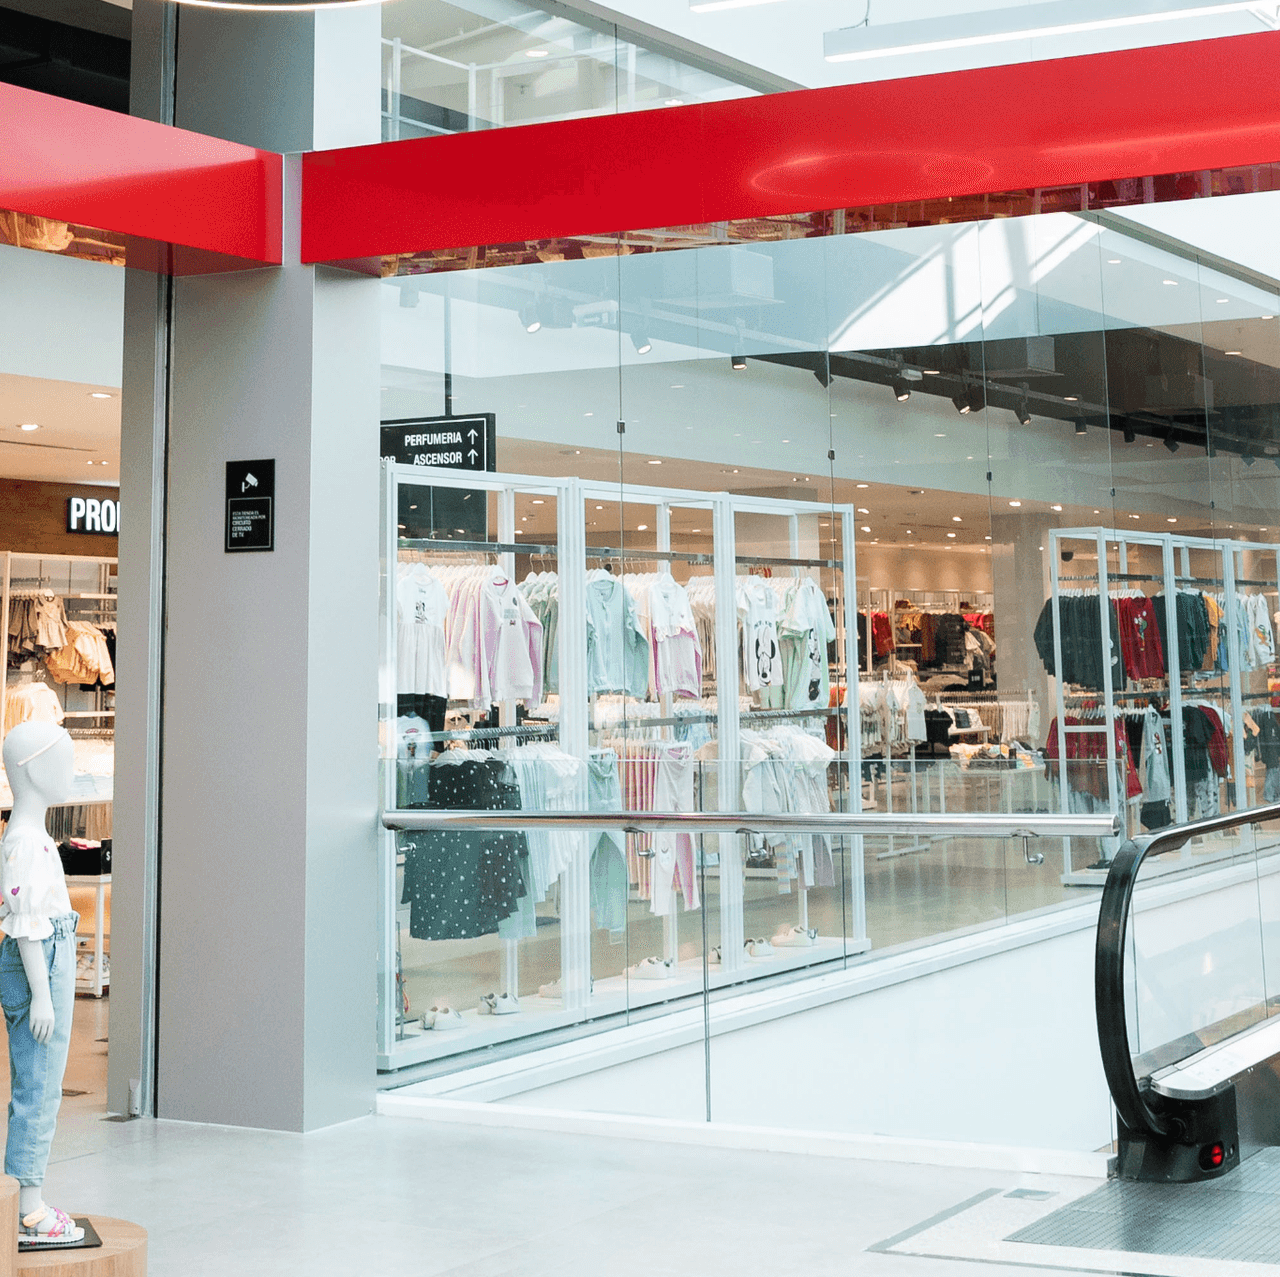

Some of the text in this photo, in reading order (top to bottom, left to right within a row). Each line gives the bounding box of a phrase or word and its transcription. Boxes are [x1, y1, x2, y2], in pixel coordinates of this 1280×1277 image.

[404, 431, 462, 447] PERFUMERIA
[413, 451, 463, 466] ASCENSOR
[70, 497, 120, 532] PRO
